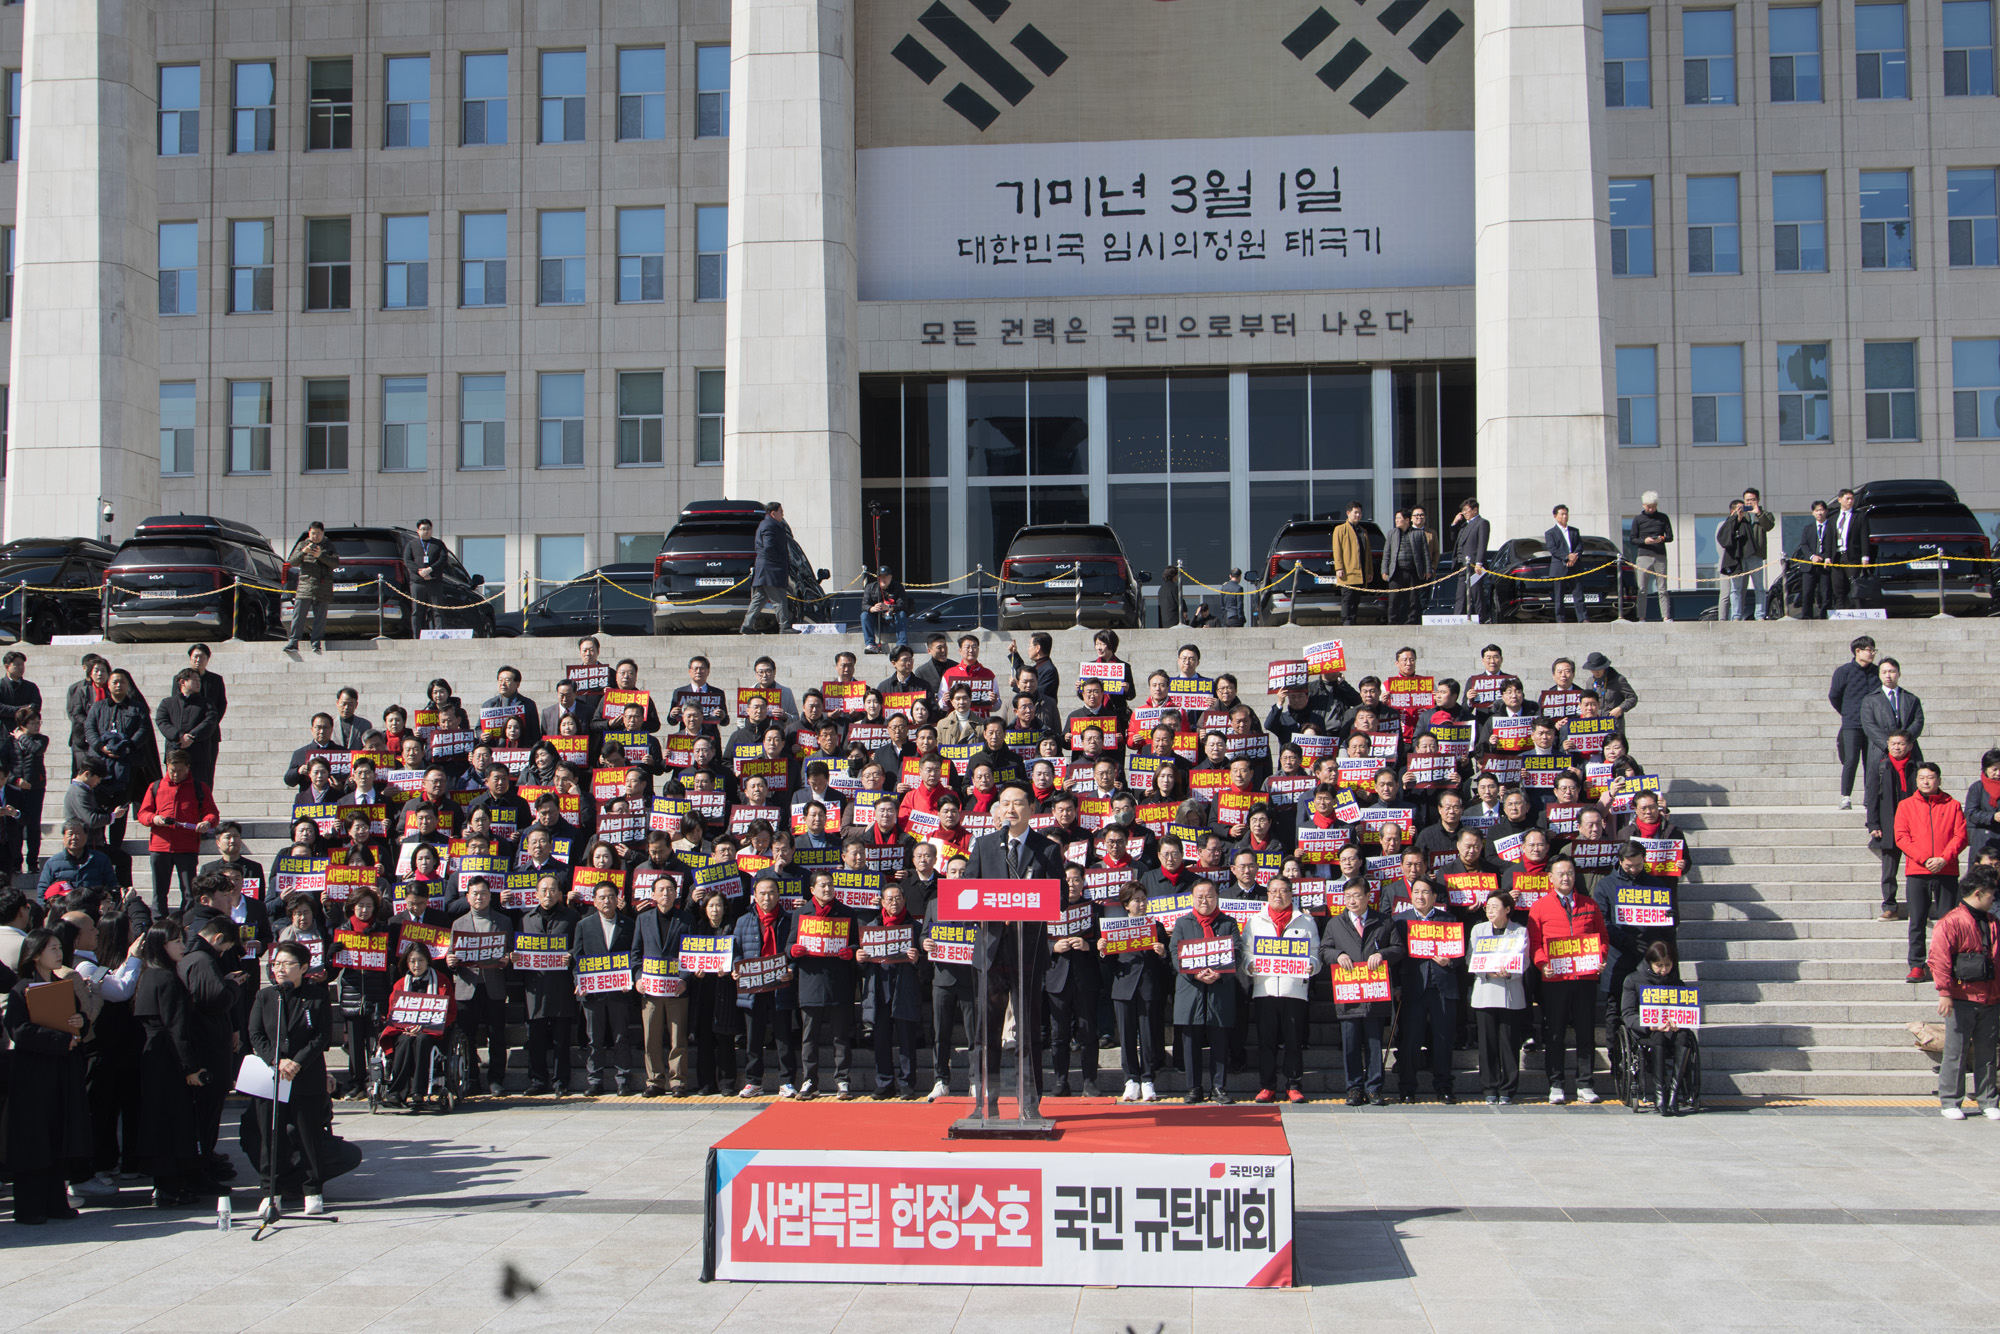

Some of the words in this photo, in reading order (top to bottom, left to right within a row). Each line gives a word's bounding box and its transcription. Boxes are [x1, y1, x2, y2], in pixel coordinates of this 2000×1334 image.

[996, 173, 1146, 218] 기미년
[1170, 169, 1253, 218] 3월
[1278, 166, 1342, 213] 1일
[958, 234, 1086, 265] 대한민국
[1103, 230, 1266, 262] 임시의정원
[1286, 227, 1382, 258] 태극기
[922, 318, 978, 346] 모든
[1001, 316, 1088, 345] 권력은
[1112, 312, 1298, 343] 국민으로부터
[1322, 309, 1414, 336] 나온다
[569, 669, 586, 679] 사법
[589, 667, 609, 677] 파괴
[1270, 665, 1285, 677] 사법
[1287, 662, 1307, 674] 파괴
[589, 678, 609, 688] 완성
[825, 685, 851, 696] 사법파괴
[853, 683, 866, 695] 3법
[1170, 680, 1196, 692] 삼권분립
[1198, 681, 1212, 693] 파괴
[1390, 678, 1418, 691] 사법파괴
[1420, 678, 1432, 691] 3법
[606, 692, 634, 703] 사법파괴
[636, 695, 647, 704] 3법
[1390, 694, 1409, 707] 대통령은
[1544, 695, 1564, 706] 사법
[1103, 719, 1115, 732] 3법
[1570, 719, 1597, 733] 삼권분립
[1600, 718, 1614, 731] 파괴
[433, 732, 452, 745] 사법
[454, 731, 474, 743] 파괴
[633, 733, 648, 745] 파괴
[851, 728, 870, 739] 사법
[575, 739, 587, 751] 3법
[1248, 737, 1267, 748] 파괴
[941, 747, 968, 759] 삼권분립
[743, 762, 771, 774] 사법파괴
[774, 762, 786, 773] 3법
[1131, 757, 1160, 769] 삼권분립
[1410, 756, 1430, 769] 사법
[1433, 755, 1455, 768] 파괴
[1525, 756, 1553, 769] 삼권분립
[1556, 755, 1571, 768] 파괴
[595, 770, 623, 784] 사법파괴
[1130, 774, 1144, 787] 당장
[1271, 780, 1292, 792] 사법
[653, 798, 675, 810] 삼권분립
[677, 801, 691, 813] 파괴
[1080, 800, 1109, 814] 사법파괴
[757, 808, 779, 820] 파괴
[599, 819, 621, 831] 사법
[623, 817, 646, 830] 파괴
[652, 815, 664, 829] 당장
[599, 833, 621, 844] 독재
[623, 831, 646, 842] 완성
[794, 850, 823, 863] 삼권분립
[826, 850, 840, 863] 파괴
[881, 847, 904, 859] 파괴
[1575, 844, 1598, 856] 사법
[280, 858, 310, 872] 삼권분립
[313, 859, 329, 872] 파괴
[462, 858, 490, 870] 삼권분립
[493, 859, 508, 872] 파괴
[880, 859, 903, 870] 완성
[327, 870, 359, 882] 사법파괴
[362, 868, 376, 881] 3법
[695, 868, 724, 884] 삼권분립
[726, 862, 738, 876] 파괴
[1109, 870, 1132, 882] 파괴
[787, 880, 801, 894] 파괴
[865, 874, 880, 888] 파괴
[1301, 880, 1324, 893] 파괴
[1482, 875, 1496, 888] 3법
[1515, 875, 1548, 889] 사법파괴
[983, 893, 1040, 909] 국민의힘
[1301, 895, 1324, 907] 완성
[1618, 887, 1651, 904] 삼권분립
[1654, 890, 1669, 905] 파괴
[1068, 905, 1091, 919] 파괴
[1617, 907, 1633, 922] 당장
[800, 919, 832, 935] 사법파괴
[835, 921, 848, 936] 3법
[1069, 919, 1092, 932] 완성
[1102, 921, 1129, 930] 사법파괴
[1130, 919, 1144, 929] 악법
[1410, 923, 1444, 939] 사법파괴
[1447, 926, 1462, 940] 3법
[403, 924, 435, 941] 사법파괴
[862, 930, 885, 943] 사법
[887, 928, 911, 941] 파괴
[931, 925, 963, 941] 삼권분립
[1108, 928, 1151, 941] 대한민국
[338, 936, 369, 949] 사법파괴
[372, 937, 387, 950] 3법
[455, 936, 479, 948] 사법
[481, 934, 505, 946] 파괴
[516, 936, 547, 951] 삼권분립
[551, 936, 566, 951] 파괴
[682, 937, 713, 951] 삼권분립
[716, 937, 731, 952] 파괴
[1106, 941, 1126, 952] 헌정
[1181, 942, 1205, 956] 사법
[1207, 938, 1232, 953] 파괴
[1256, 938, 1289, 954] 삼권분립
[1292, 939, 1309, 955] 파괴
[1550, 940, 1581, 956] 사법파괴
[1583, 937, 1599, 952] 3법
[480, 946, 504, 959] 완성
[1410, 940, 1435, 956] 대통령은
[1436, 942, 1463, 957] 거부하라!
[360, 952, 386, 967] 거부하라!
[579, 956, 610, 972] 삼권분립
[613, 954, 629, 968] 파괴
[681, 955, 696, 969] 당장
[739, 959, 761, 974] 사법
[762, 955, 785, 970] 파괴
[1181, 956, 1206, 969] 독재
[1207, 951, 1233, 966] 완성
[1256, 958, 1271, 974] 당장
[1273, 958, 1308, 975] 중단하라!
[1472, 956, 1486, 970] 당장
[1334, 966, 1368, 982] 사법파괴
[580, 977, 595, 991] 당장
[597, 973, 629, 989] 중단하라!
[1335, 984, 1360, 1000] 대통령은
[1361, 982, 1388, 999] 거부하라!
[1642, 988, 1677, 1004] 삼권분립
[1680, 990, 1698, 1005] 파괴
[395, 996, 421, 1009] 사법
[423, 997, 448, 1011] 파괴
[392, 1011, 417, 1023] 독재
[418, 1011, 445, 1023] 완성
[1643, 1009, 1658, 1023] 당장
[1661, 1010, 1697, 1025] 중단하라!
[1230, 1166, 1275, 1178] 국민의힘
[742, 1182, 880, 1248] 사법독립
[890, 1182, 1032, 1251] 헌정수호
[1054, 1186, 1124, 1251] 국민
[1134, 1187, 1276, 1253] 규탄대회
